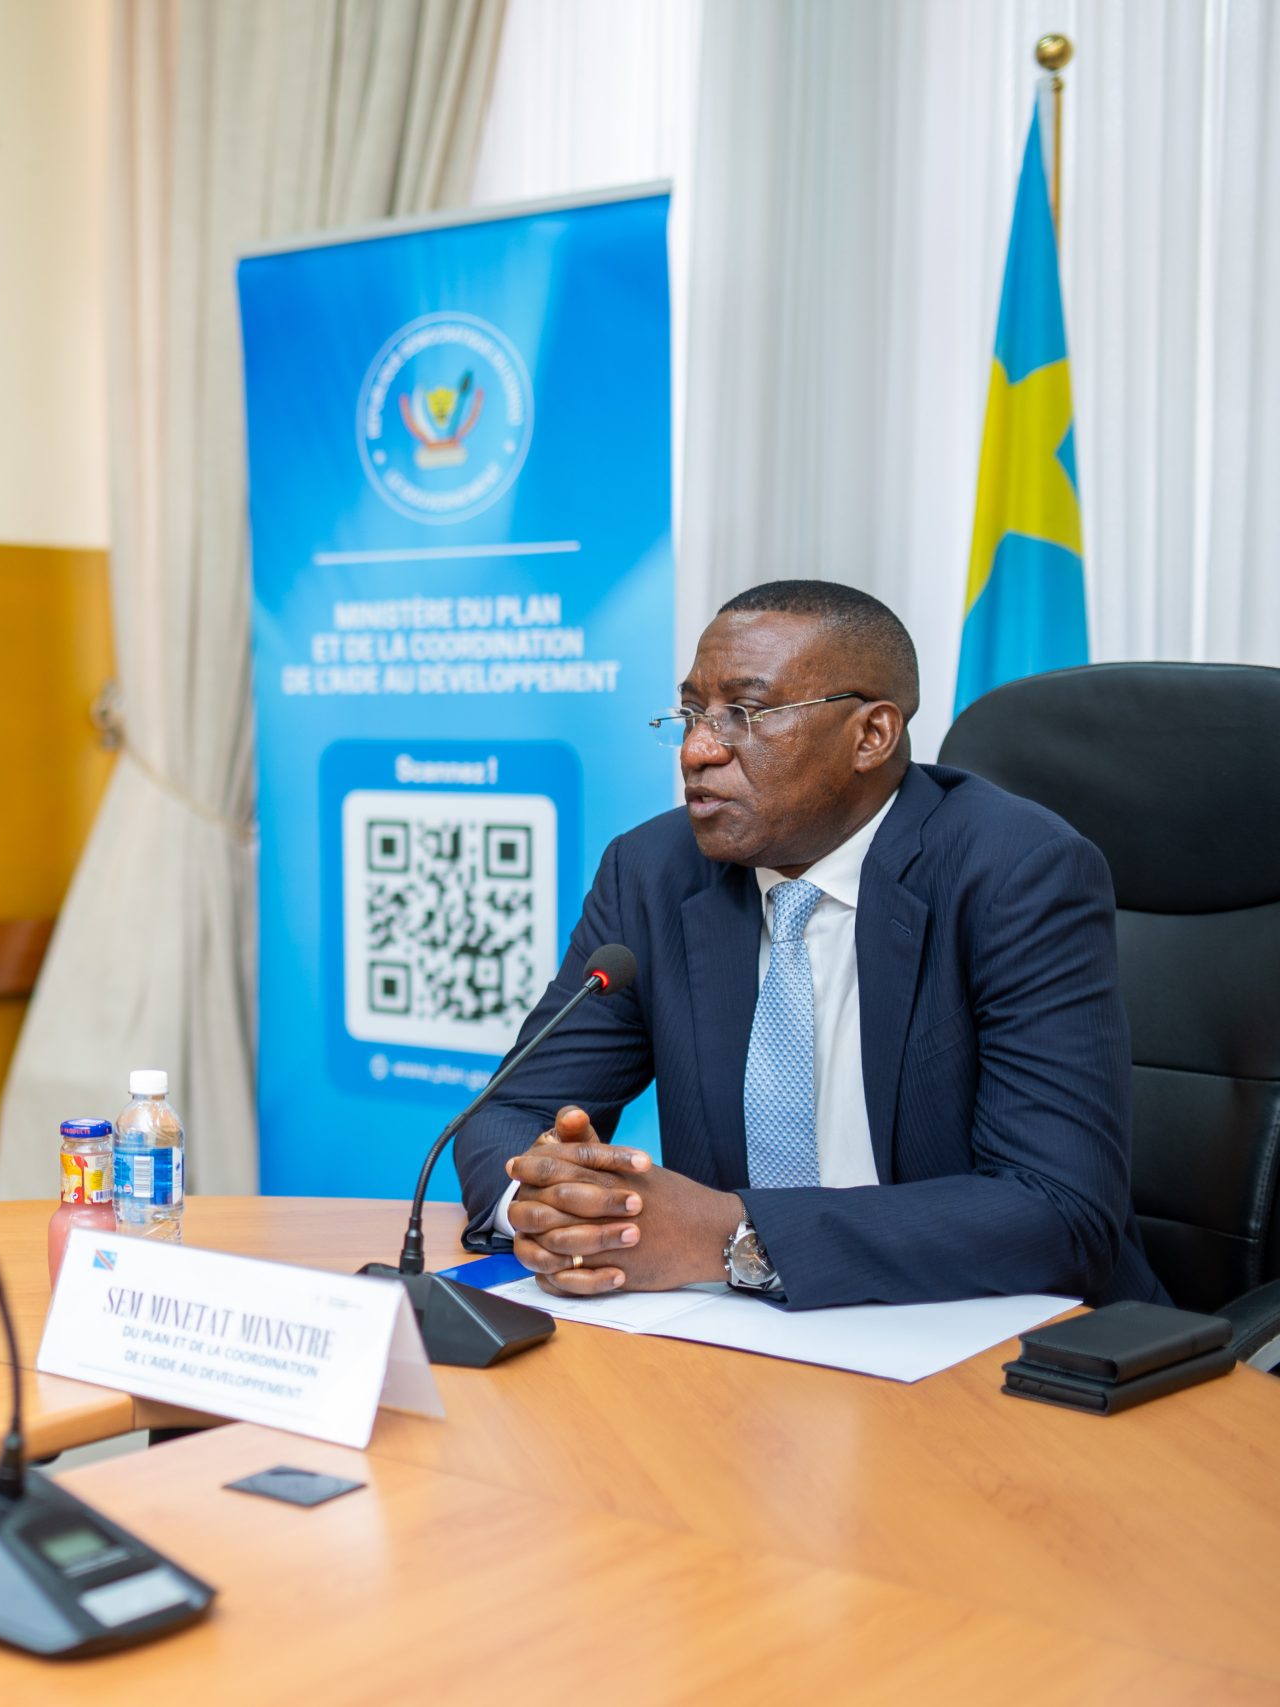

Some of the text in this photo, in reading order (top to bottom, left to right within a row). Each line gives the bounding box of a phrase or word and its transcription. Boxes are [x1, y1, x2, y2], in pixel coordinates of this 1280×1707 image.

[457, 598, 493, 628] DU
[496, 593, 562, 626] PLAN
[311, 627, 584, 664] ET DE LA COORDINATION
[281, 664, 312, 695] DE
[382, 664, 415, 694] AU
[395, 753, 485, 784] Scannez
[103, 1286, 144, 1320] SEM
[239, 1312, 336, 1361] MINISTRE
[122, 1324, 319, 1378] DU PLAN ET DE LA COORDINATION
[124, 1348, 139, 1362] DE
[179, 1360, 197, 1376] AU
